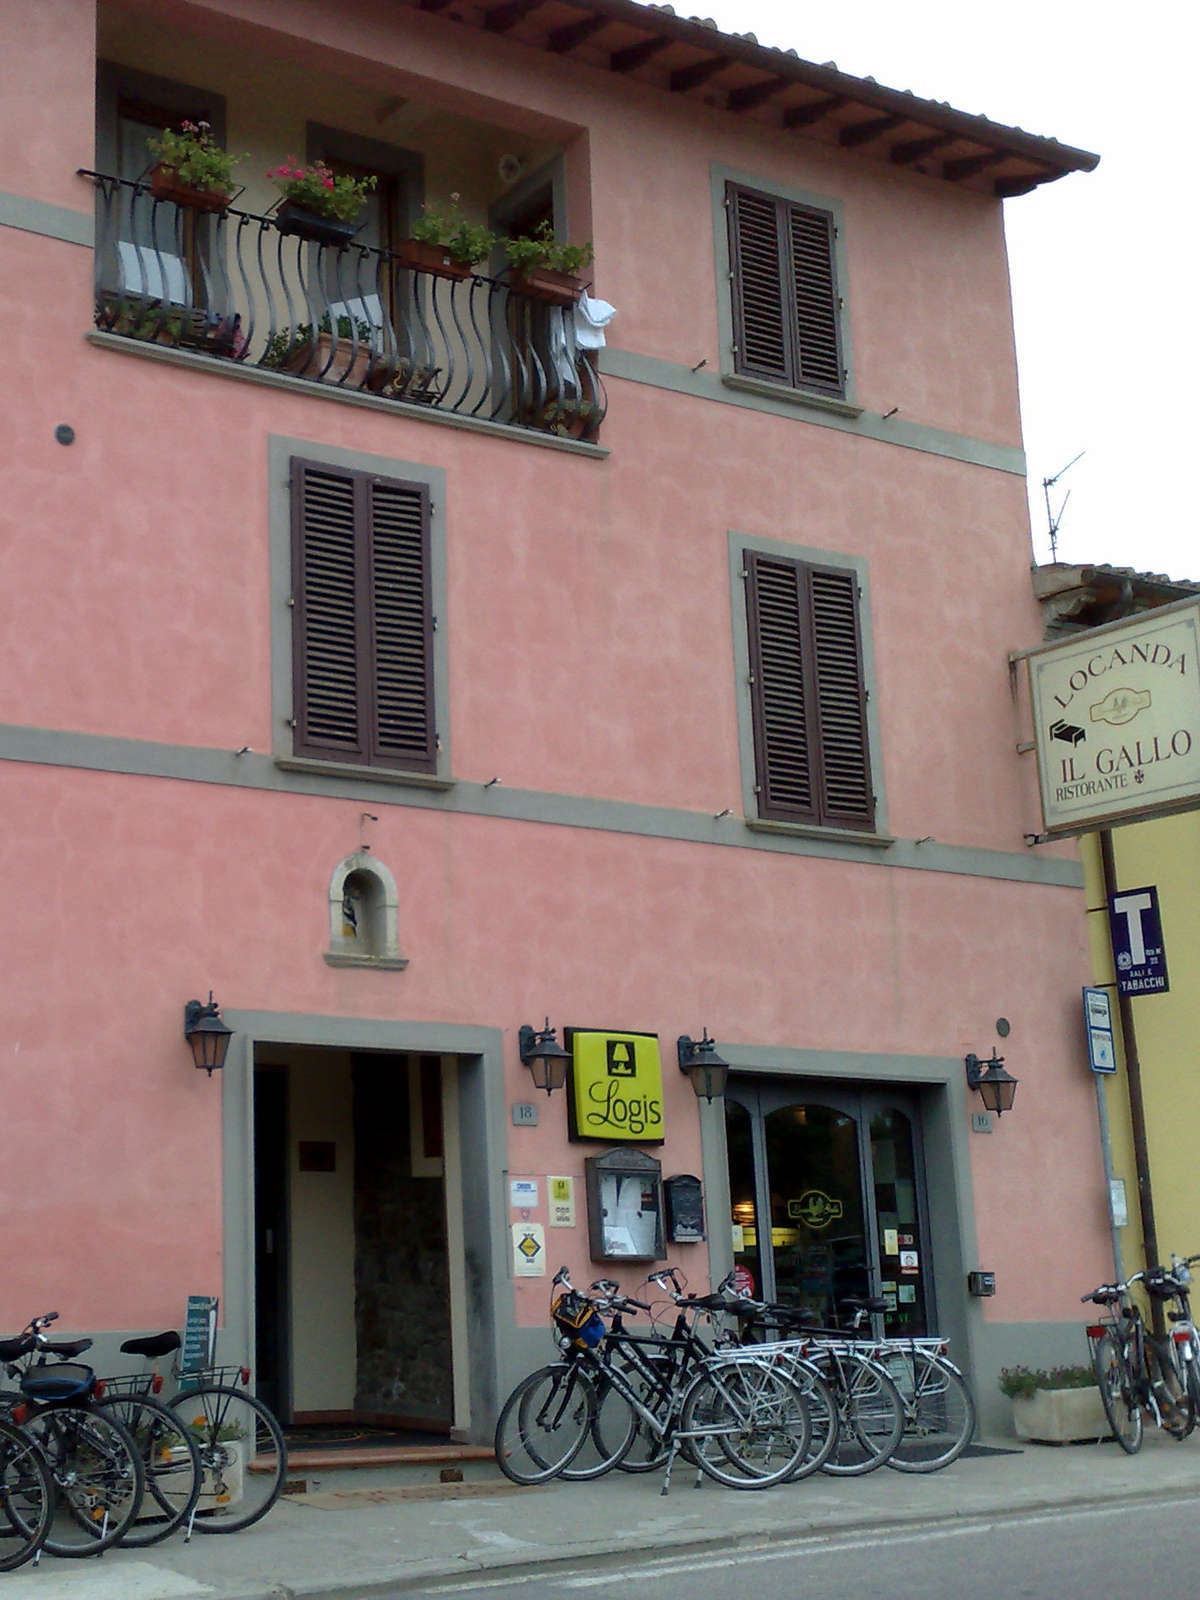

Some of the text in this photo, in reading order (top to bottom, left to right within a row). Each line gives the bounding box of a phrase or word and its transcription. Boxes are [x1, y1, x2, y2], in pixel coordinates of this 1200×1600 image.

[1054, 643, 1187, 709] LOCANDA
[1061, 729, 1192, 783] IL GALLO
[1056, 773, 1128, 802] RISTORANTE
[1114, 893, 1151, 965] T
[1121, 976, 1164, 991] TABACCHI
[586, 1079, 662, 1134] Logis
